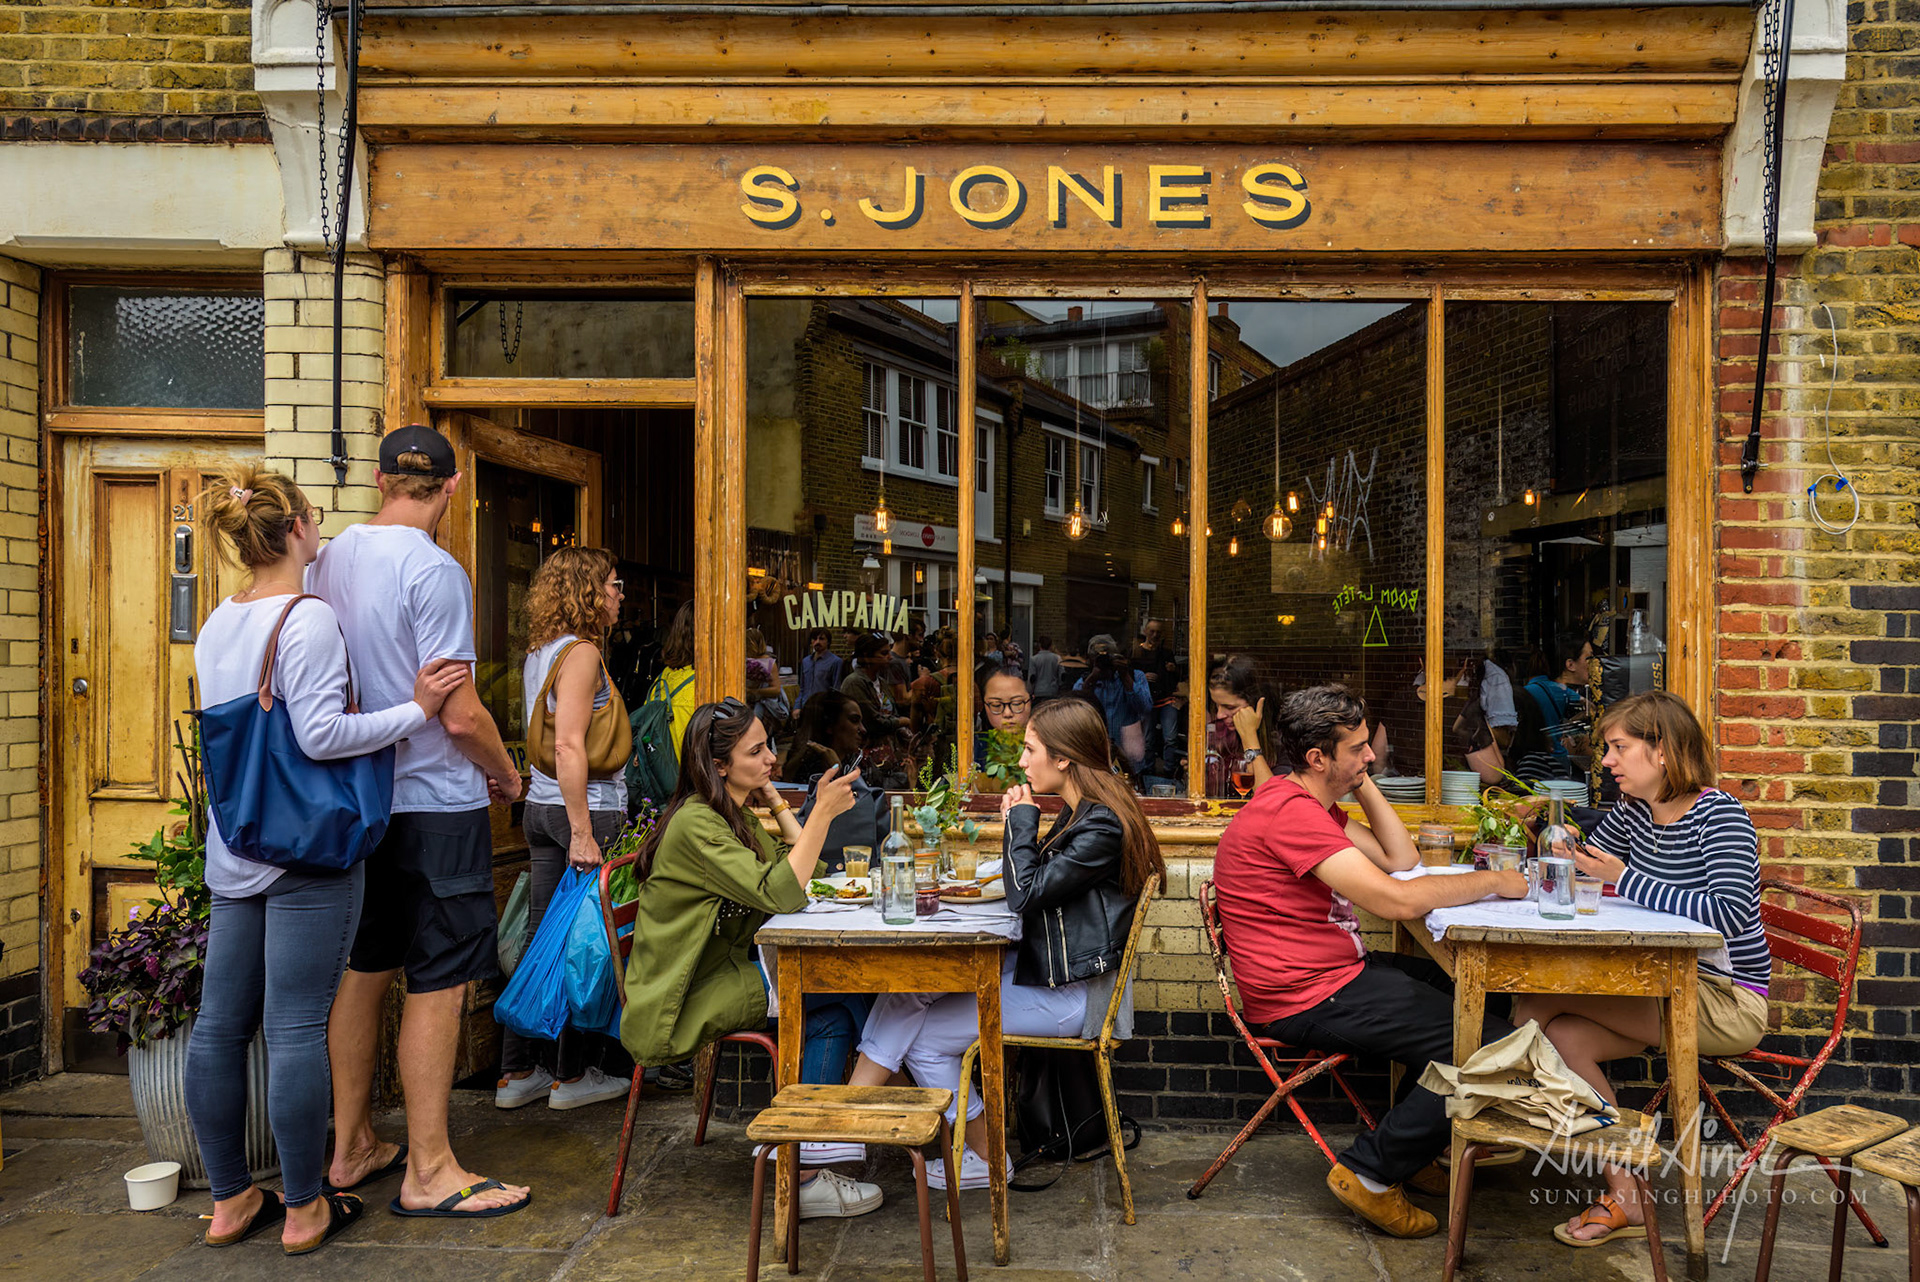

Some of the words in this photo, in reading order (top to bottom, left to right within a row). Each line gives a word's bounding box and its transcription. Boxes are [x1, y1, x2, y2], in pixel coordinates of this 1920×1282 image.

[740, 165, 836, 230] S.
[858, 163, 1312, 231] JONES
[172, 503, 195, 522] 21
[783, 590, 909, 635] CAMPANIA
